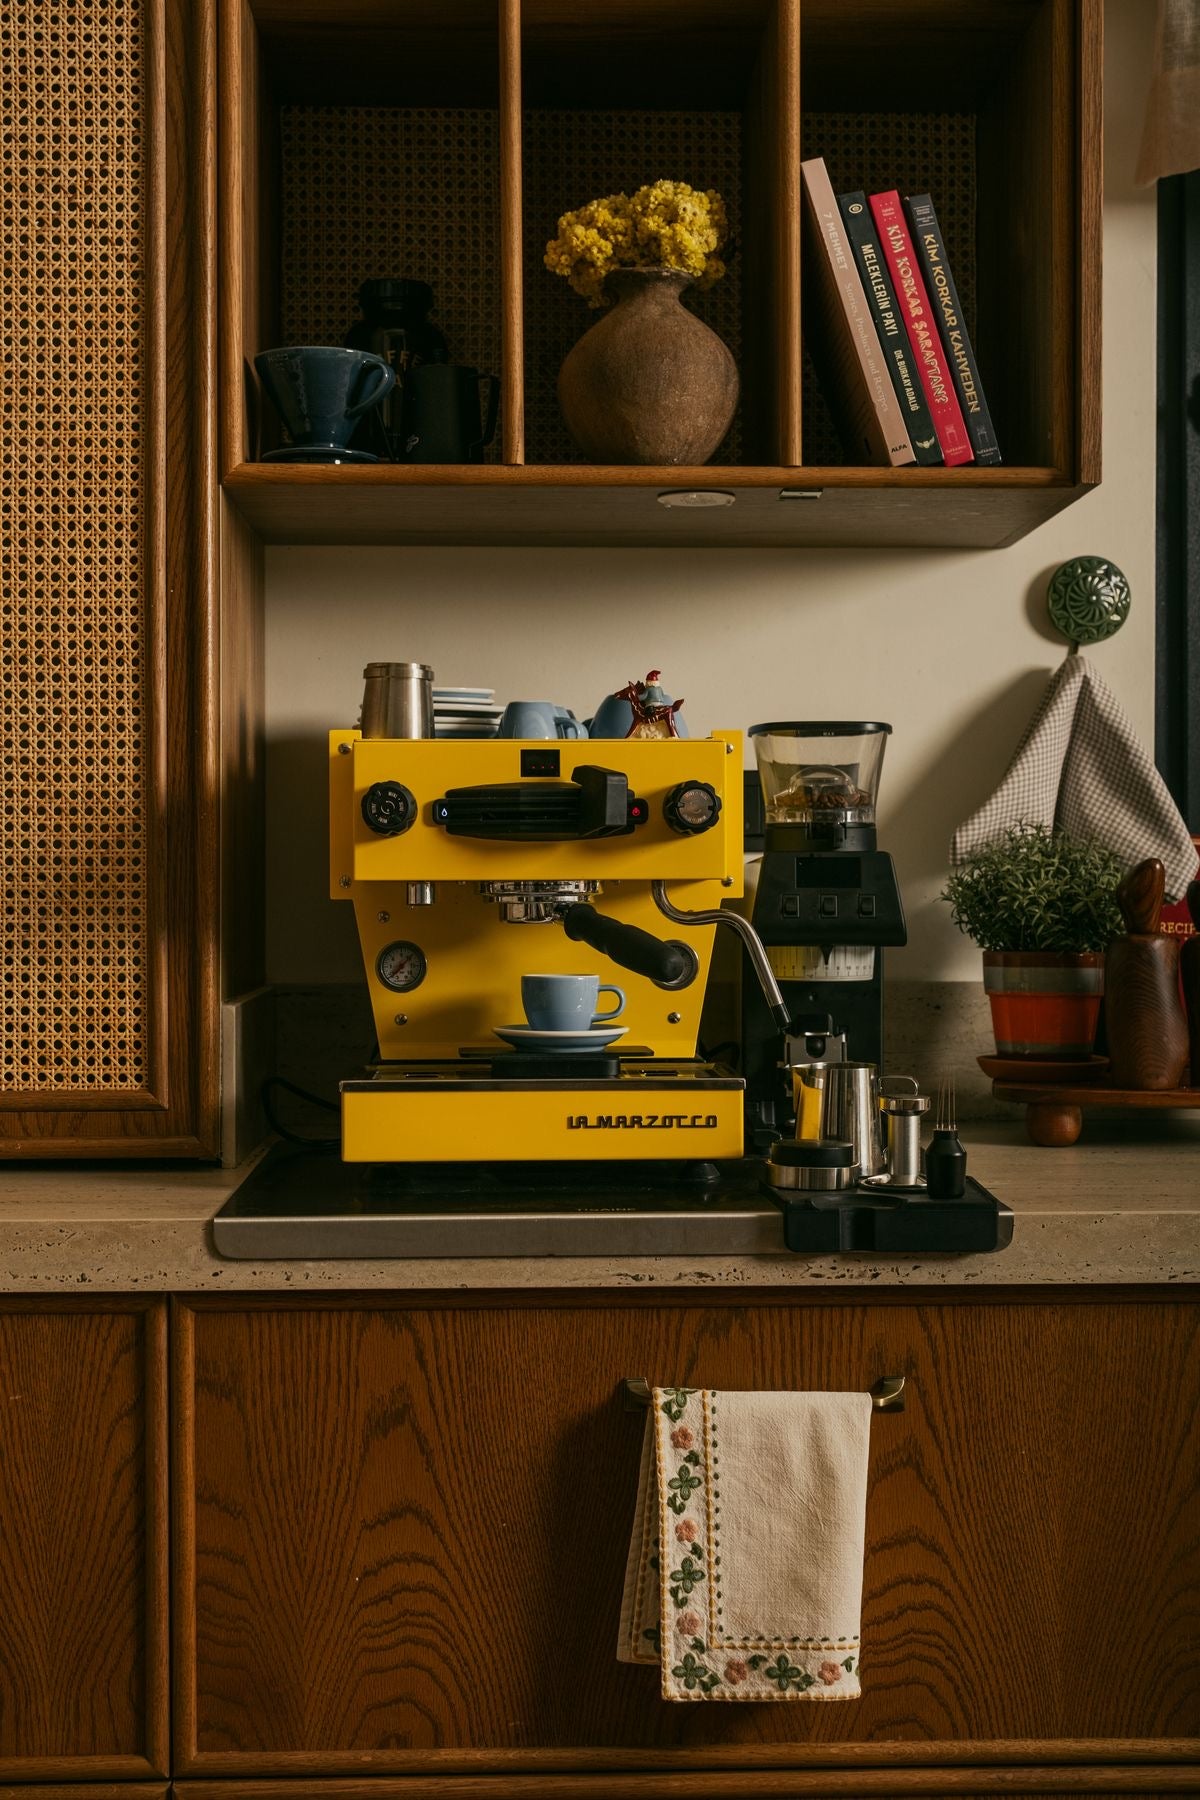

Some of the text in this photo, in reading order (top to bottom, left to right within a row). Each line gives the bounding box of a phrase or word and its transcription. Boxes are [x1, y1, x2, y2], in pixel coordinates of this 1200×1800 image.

[828, 221, 848, 271] MEHMET
[886, 223, 908, 253] KİM
[923, 233, 942, 263] KİM
[860, 242, 892, 310] MELEKLERİN
[880, 310, 898, 336] PAYI
[895, 256, 924, 317] KORKAR
[931, 265, 958, 328] KORKAR
[854, 317, 873, 357] Products
[866, 357, 879, 375] and
[910, 319, 949, 406] ŞARAPTAN?
[948, 330, 981, 414] KAHVEDEN
[870, 375, 890, 413] Recipes
[891, 443, 908, 454] ALFA
[566, 1115, 588, 1130] LA
